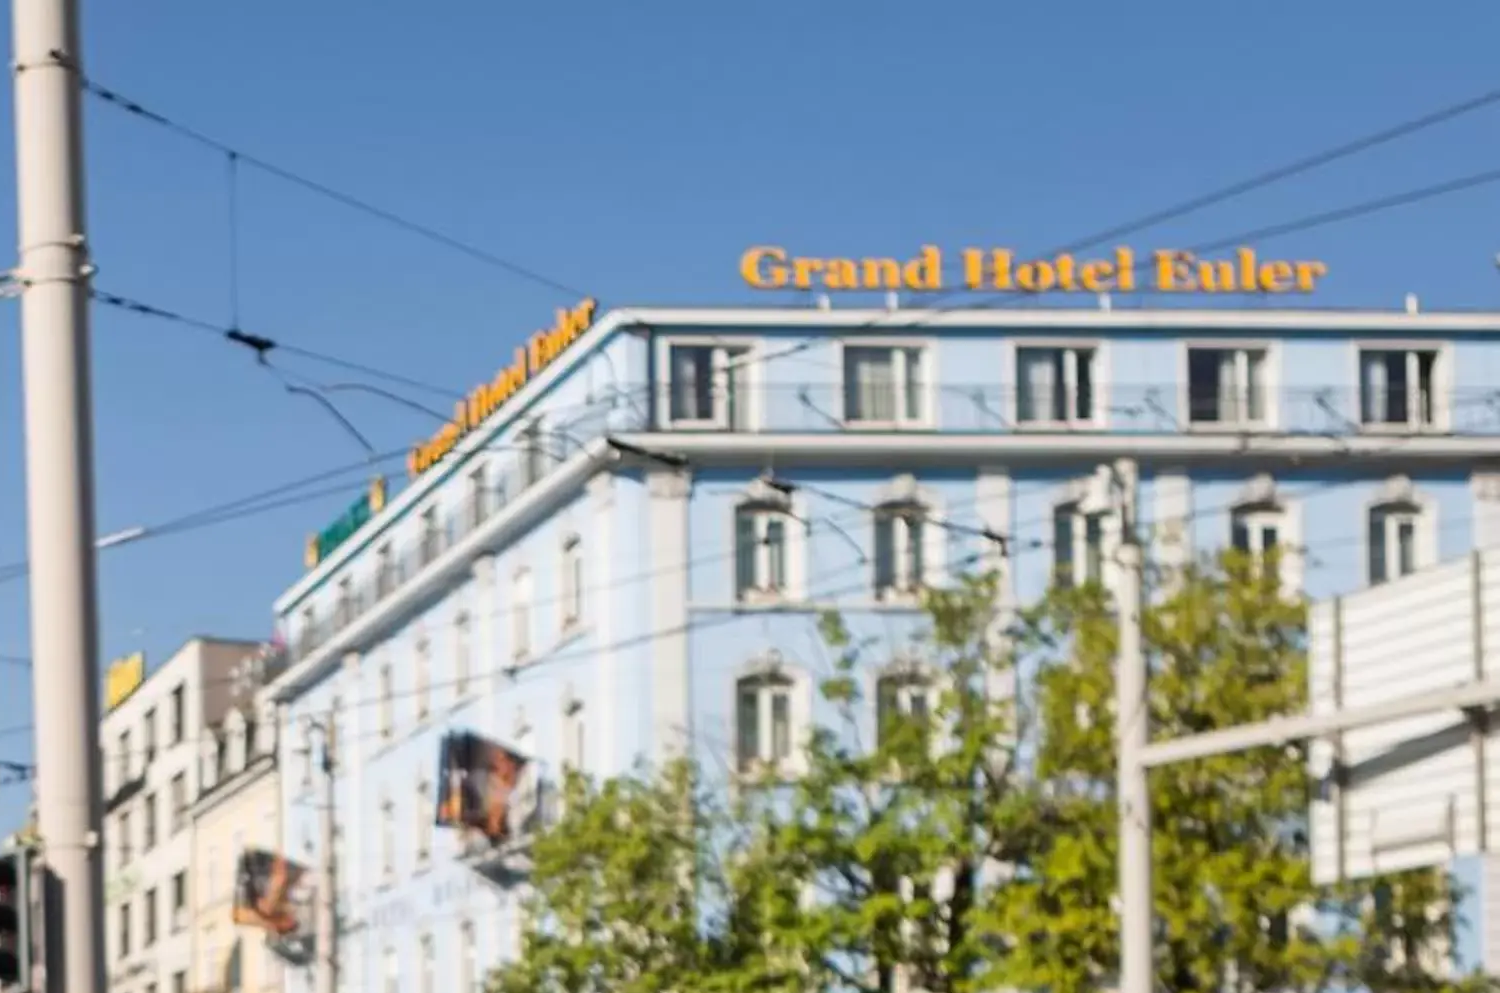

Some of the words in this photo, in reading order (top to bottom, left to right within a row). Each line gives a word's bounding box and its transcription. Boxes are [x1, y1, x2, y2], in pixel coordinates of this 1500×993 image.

[740, 247, 941, 290] Grand
[962, 248, 1134, 290] Hotel
[1155, 249, 1328, 291] Euler
